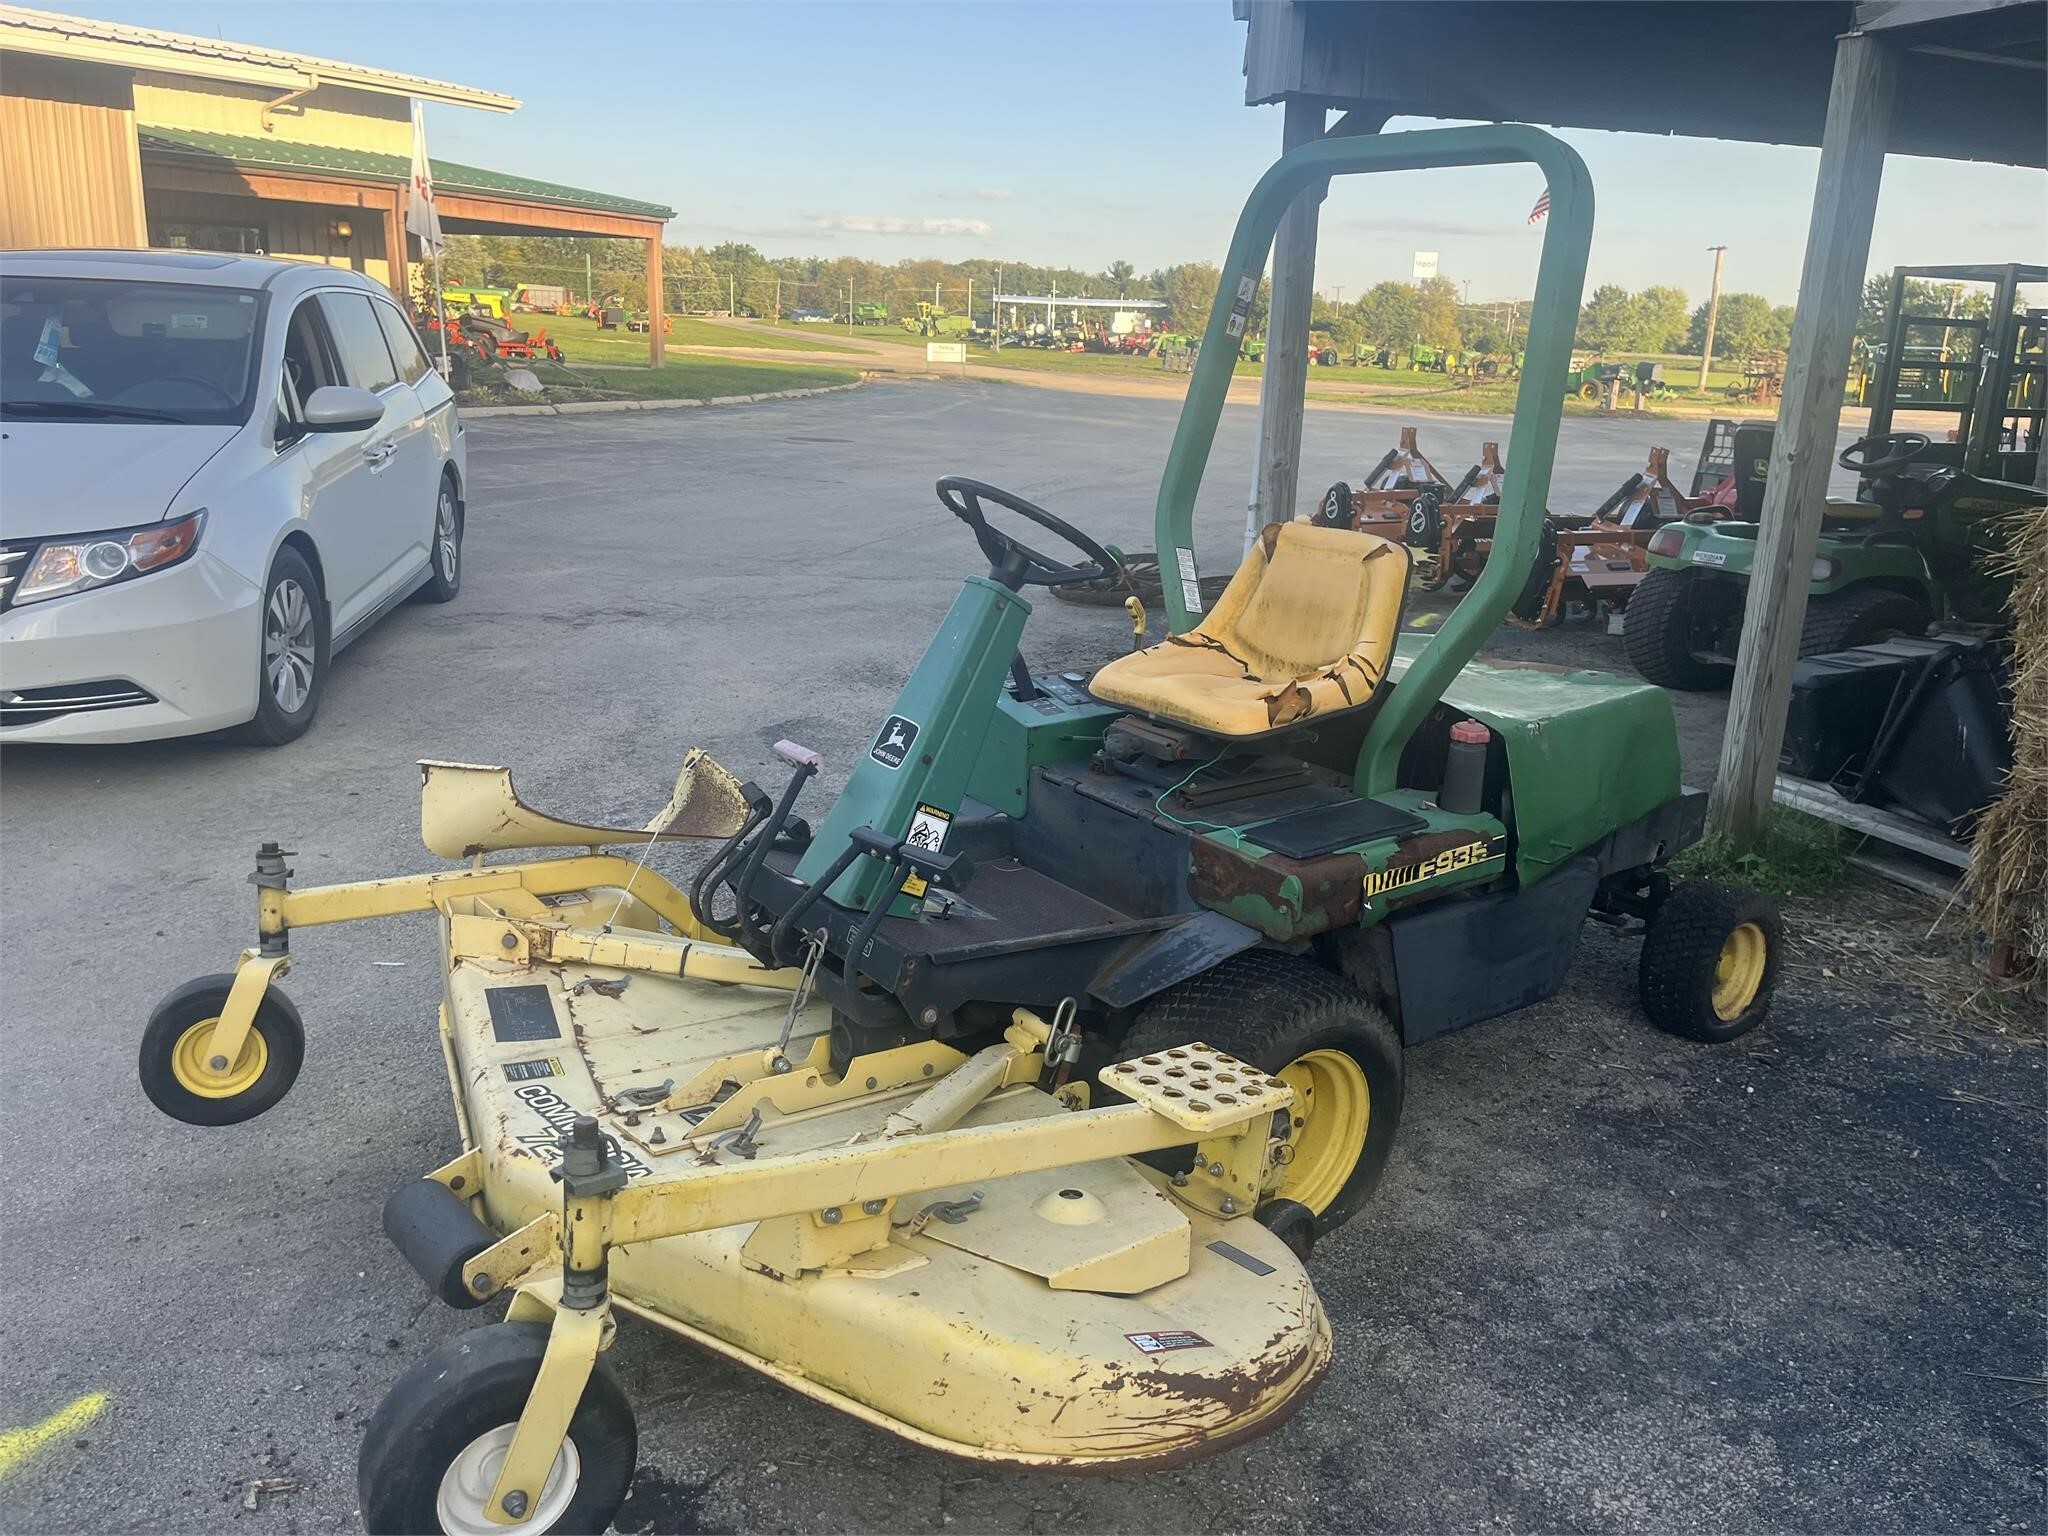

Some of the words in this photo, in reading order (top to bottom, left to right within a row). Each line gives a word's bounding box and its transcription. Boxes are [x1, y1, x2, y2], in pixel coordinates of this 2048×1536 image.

[873, 747, 887, 758] JOHN
[885, 752, 901, 765] DEERE
[925, 805, 950, 820] WARNING
